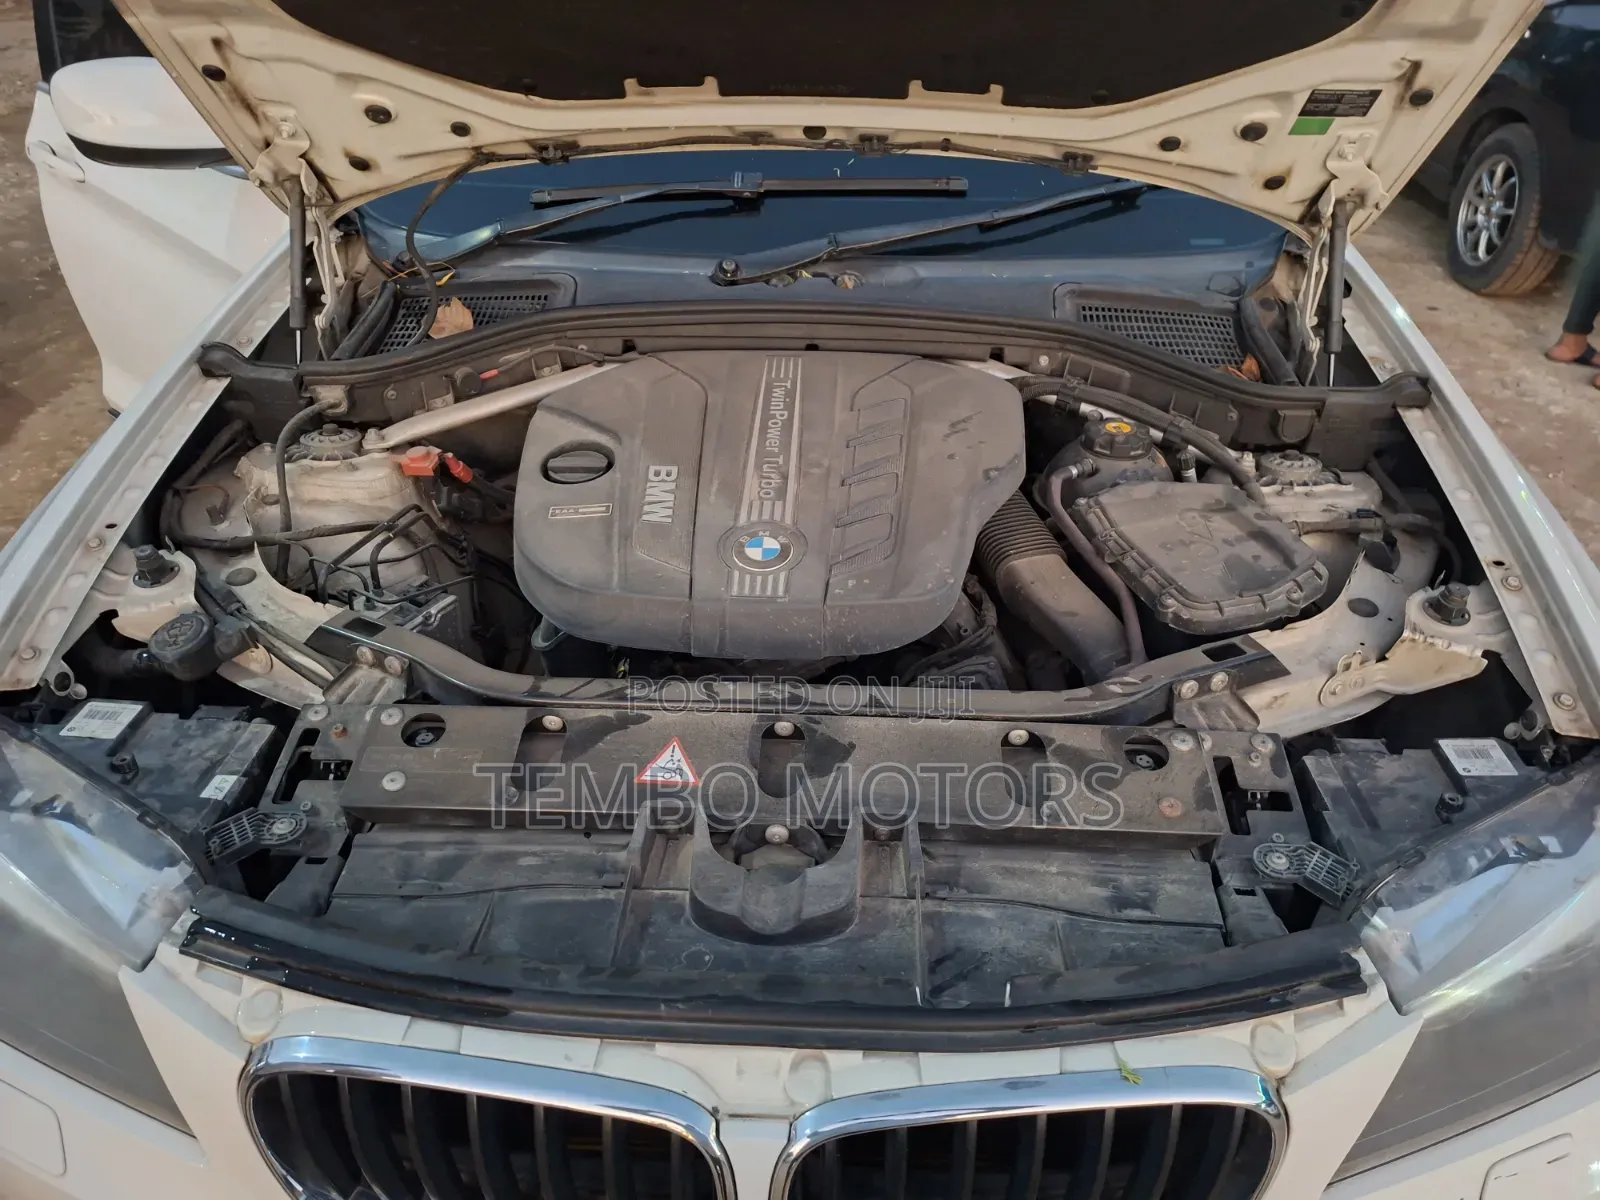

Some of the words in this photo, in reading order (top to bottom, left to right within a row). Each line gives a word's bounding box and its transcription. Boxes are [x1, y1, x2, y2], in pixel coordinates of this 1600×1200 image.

[764, 379, 792, 452] TwinPower
[641, 465, 679, 524] BMW
[759, 455, 784, 498] Turbo
